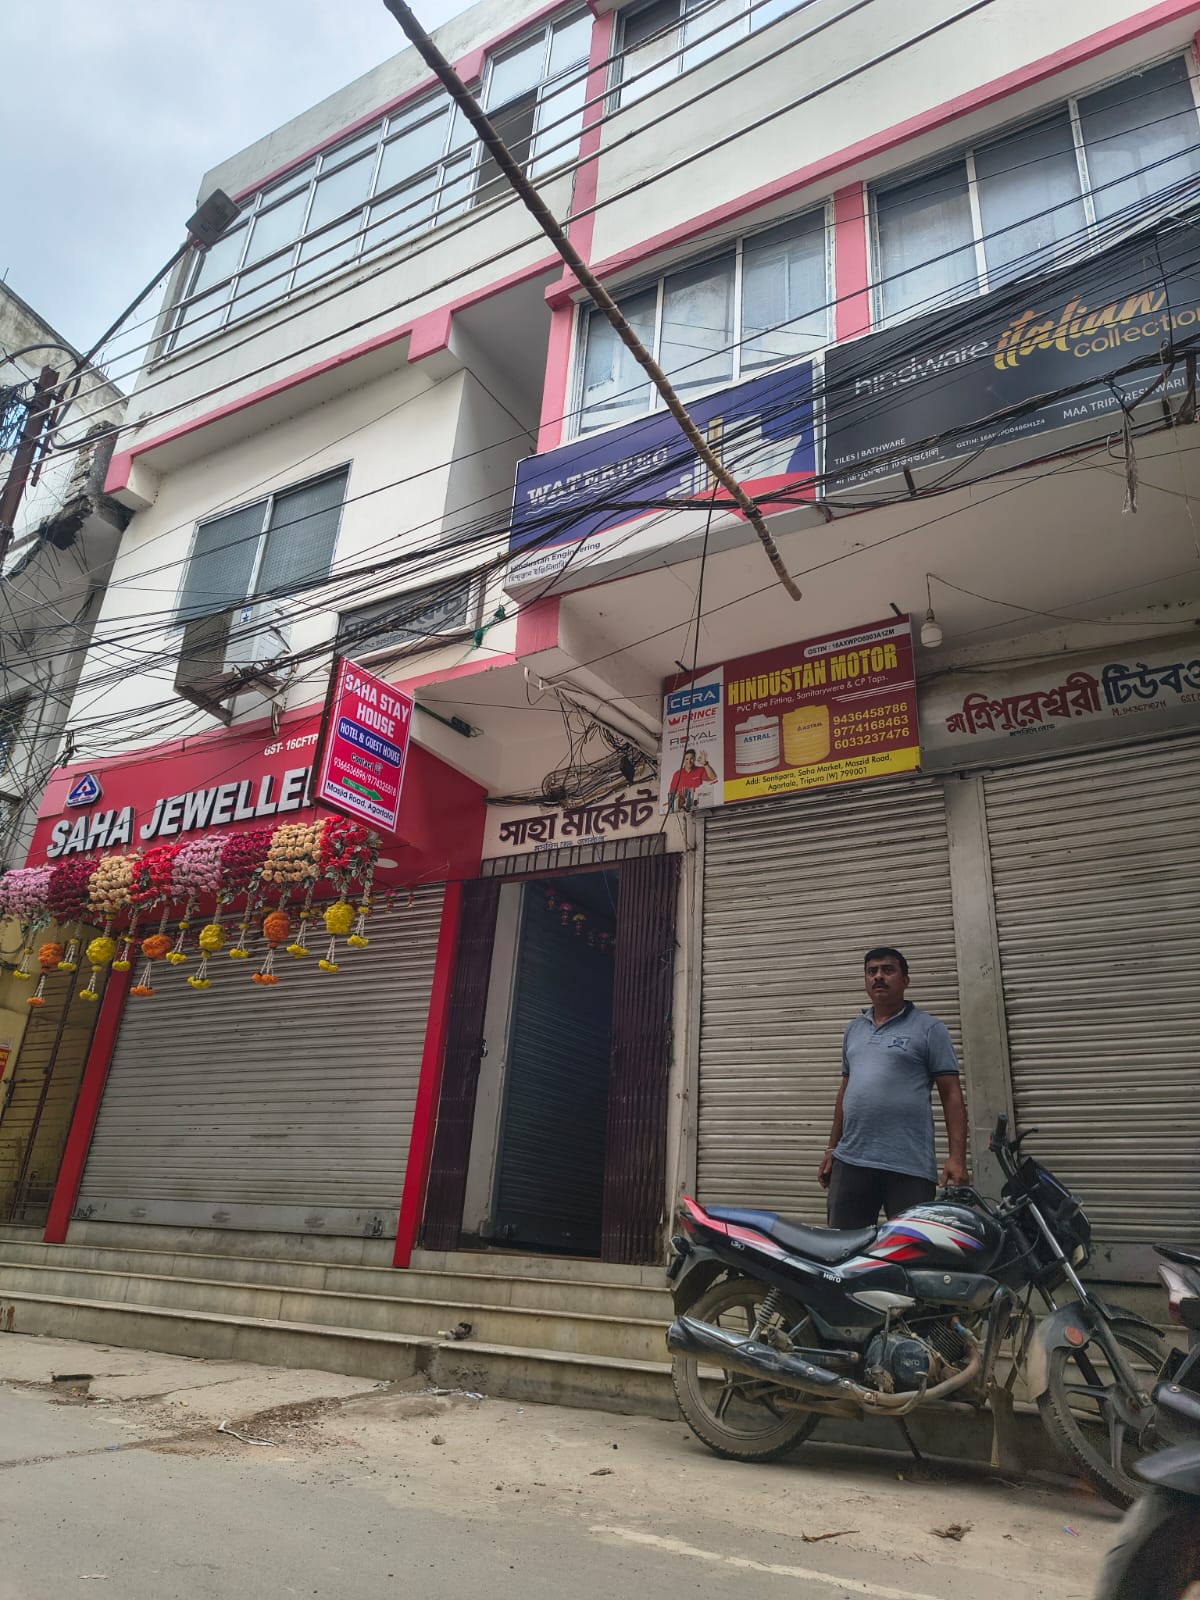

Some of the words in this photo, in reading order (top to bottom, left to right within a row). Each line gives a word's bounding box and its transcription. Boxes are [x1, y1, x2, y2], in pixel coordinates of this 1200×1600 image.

[1073, 306, 1200, 358] collectio
[1063, 404, 1088, 419] MAA
[1091, 377, 1185, 411] TRIPURESWARI
[834, 452, 856, 465] TILES
[861, 438, 906, 457] BATHWARE
[551, 541, 601, 561] Enginering
[727, 659, 826, 706] HINDUSTAN
[830, 643, 898, 683] MOTOR
[345, 674, 377, 706] SAHA
[380, 689, 409, 723] STAY
[671, 690, 716, 709] CERA
[736, 702, 750, 713] PVC
[753, 701, 768, 712] Pipe
[847, 680, 853, 689] &
[854, 676, 866, 687] CP
[356, 702, 395, 738] HOUSE
[681, 707, 719, 723] PRINCE
[833, 702, 908, 726] 9436458786
[833, 715, 909, 738] 9774168463
[264, 741, 284, 756] GST-
[340, 721, 359, 742] HOTEL
[359, 732, 365, 744] &
[365, 735, 383, 754] GUEST
[383, 744, 400, 764] HOUSE
[743, 732, 771, 744] ASTRAL
[834, 727, 910, 750] 6033237476
[798, 768, 815, 777] Saha
[800, 775, 825, 786] Tripura
[826, 771, 838, 782] (W)
[840, 766, 867, 778] 799001
[47, 805, 135, 858] SAHA
[139, 766, 314, 840] JEWELLE
[326, 782, 348, 799] Masjid
[367, 803, 394, 821] Agartala
[498, 813, 558, 846] সাহা
[561, 788, 658, 837] মার্কেট
[823, 1272, 842, 1284] Hero
